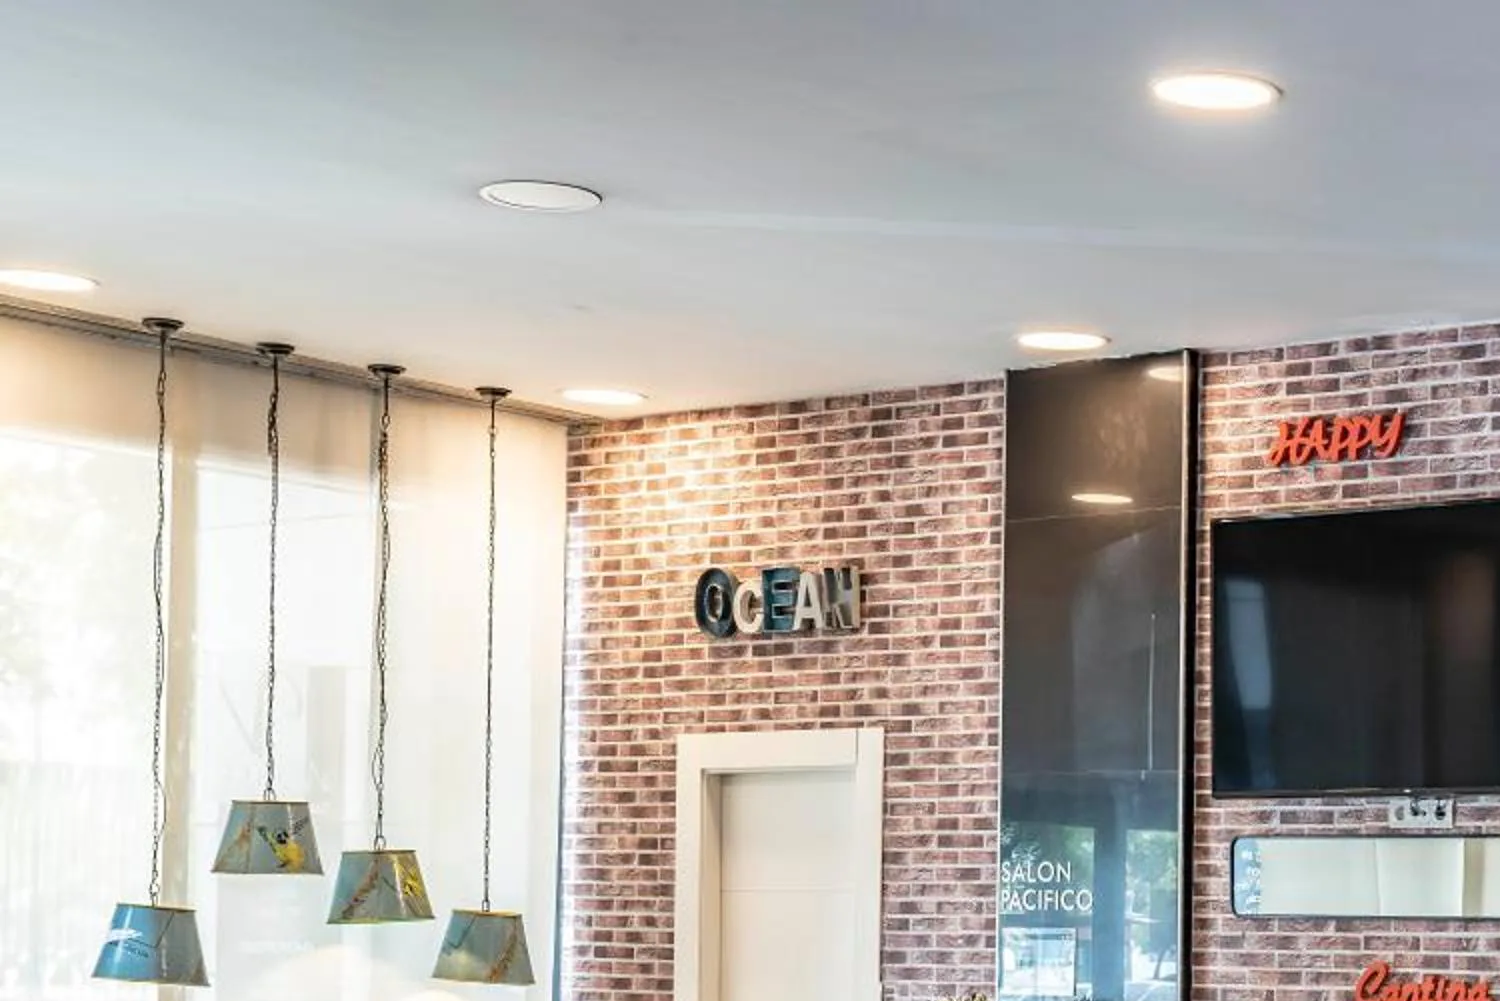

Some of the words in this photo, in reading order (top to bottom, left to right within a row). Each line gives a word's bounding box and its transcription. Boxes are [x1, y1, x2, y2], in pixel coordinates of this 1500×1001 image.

[1268, 411, 1406, 466] HAPPY
[695, 565, 862, 638] OCEAN
[1001, 860, 1072, 883] SALON
[1001, 888, 1094, 912] PACIFICO
